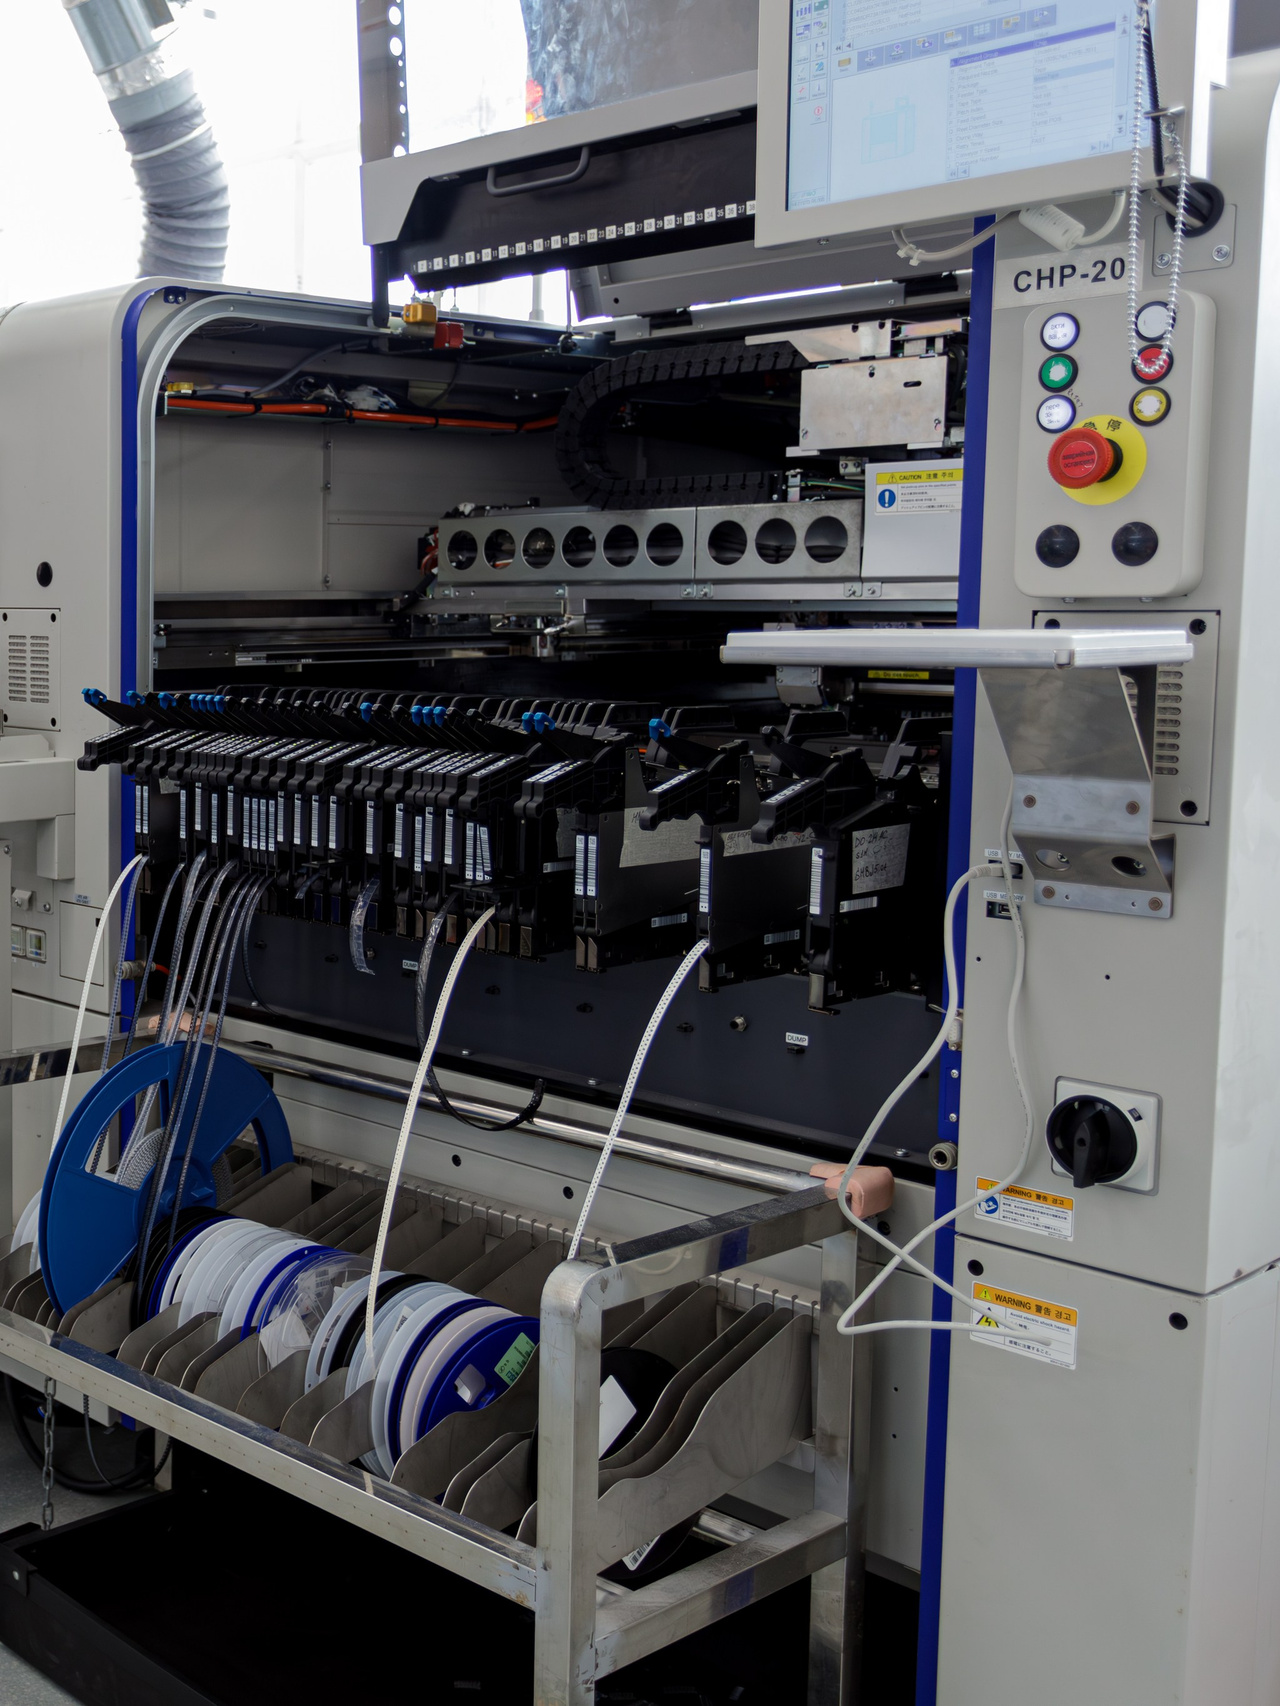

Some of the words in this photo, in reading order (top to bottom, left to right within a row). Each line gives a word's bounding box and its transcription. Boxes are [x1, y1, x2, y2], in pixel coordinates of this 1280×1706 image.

[580, 234, 586, 242] 21
[589, 232, 595, 240] 22
[608, 229, 614, 237] 24
[617, 227, 624, 235] 25
[646, 222, 652, 230] 28
[656, 220, 663, 228] 29
[686, 215, 693, 223] 32
[696, 213, 703, 221] 33
[707, 211, 713, 219] 34
[717, 209, 724, 217] 35
[728, 207, 734, 215] 36
[738, 205, 745, 214] 37
[1013, 257, 1126, 293] CHP-20
[1000, 893, 1024, 901] MERY
[787, 1034, 807, 1042] DUMP
[995, 1293, 1032, 1311] WARNING
[1023, 1315, 1039, 1324] electric
[1040, 1320, 1053, 1328] shock
